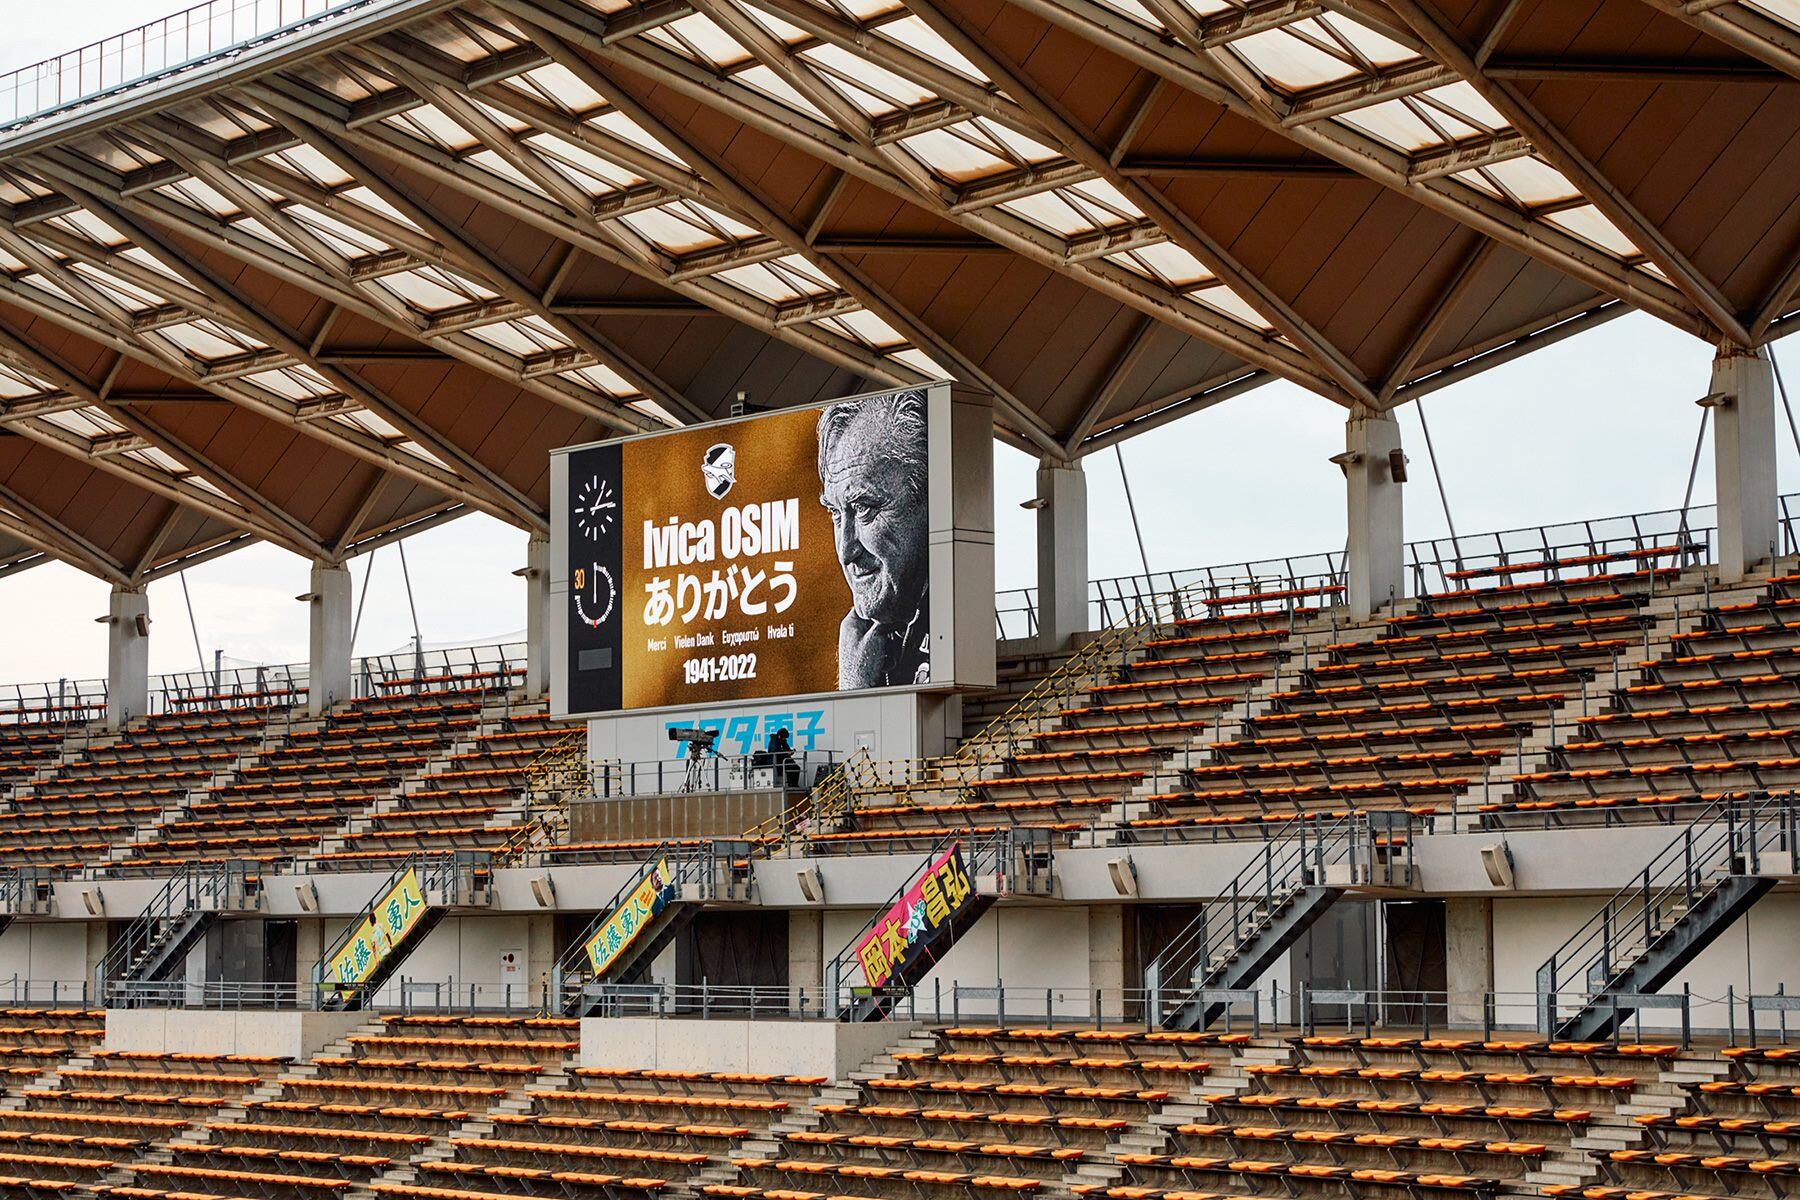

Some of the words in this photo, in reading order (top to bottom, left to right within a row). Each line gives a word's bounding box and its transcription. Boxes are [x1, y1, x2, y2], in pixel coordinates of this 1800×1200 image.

[643, 516, 715, 570] Ivica
[721, 498, 800, 560] OSIM
[574, 568, 585, 590] 30
[643, 561, 798, 627] ありがとう
[647, 637, 667, 652] Merci
[674, 634, 696, 649] Vielen
[696, 632, 715, 647] Dank
[767, 624, 788, 639] Hvala
[788, 623, 795, 637] ti
[683, 652, 757, 684] 1941-2022
[859, 918, 910, 988] 岡本
[920, 854, 971, 929] 昌弘
[337, 937, 372, 983] 佐藤
